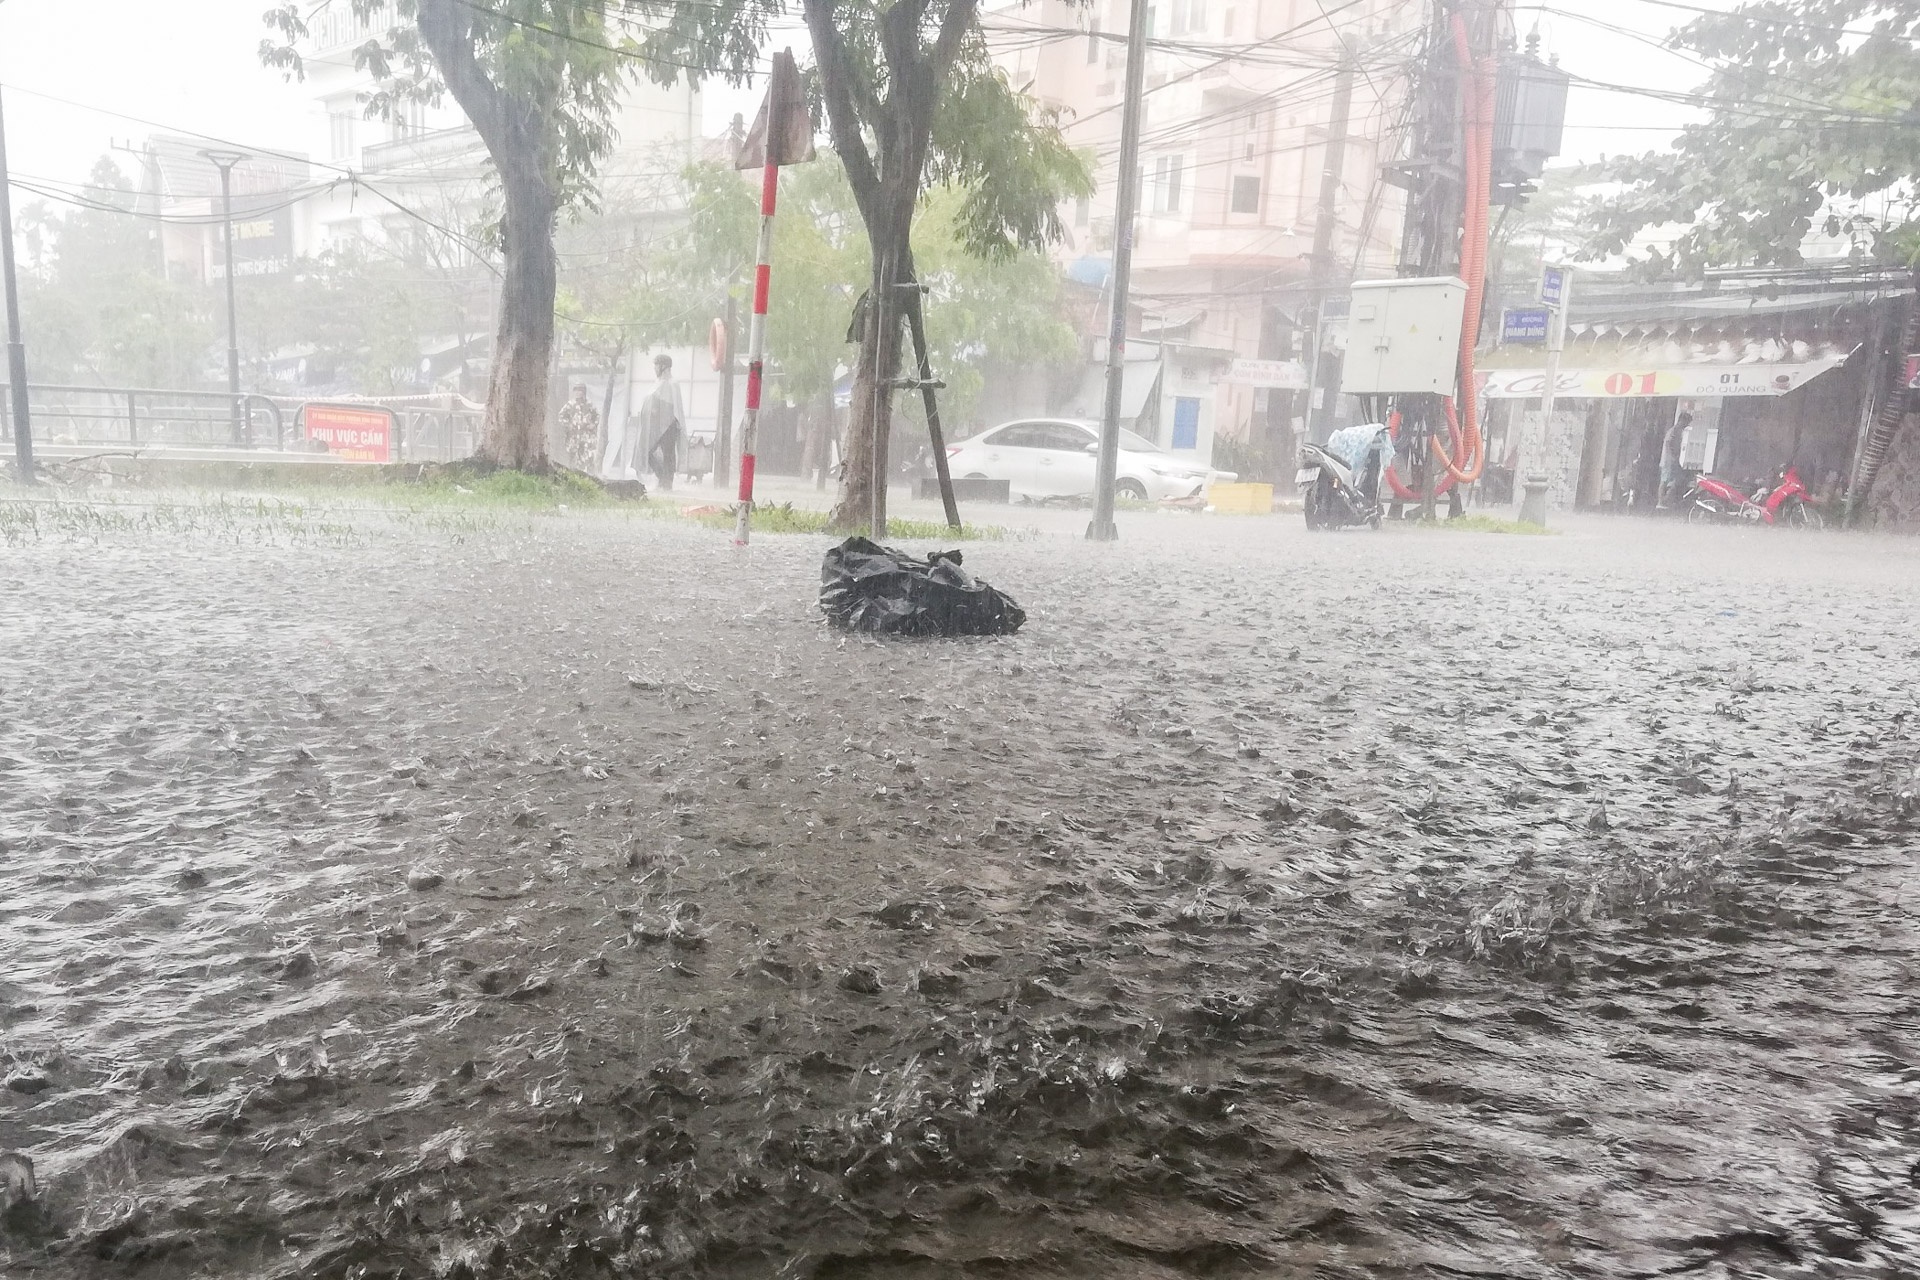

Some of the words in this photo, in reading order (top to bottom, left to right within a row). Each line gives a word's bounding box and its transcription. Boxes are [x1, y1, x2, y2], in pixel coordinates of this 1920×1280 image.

[1604, 371, 1660, 395] 01
[1720, 373, 1740, 384] 01
[1718, 385, 1767, 394] QUANG
[311, 427, 334, 442] KHU
[336, 428, 358, 446] VỰC
[360, 427, 384, 446] CẤM
